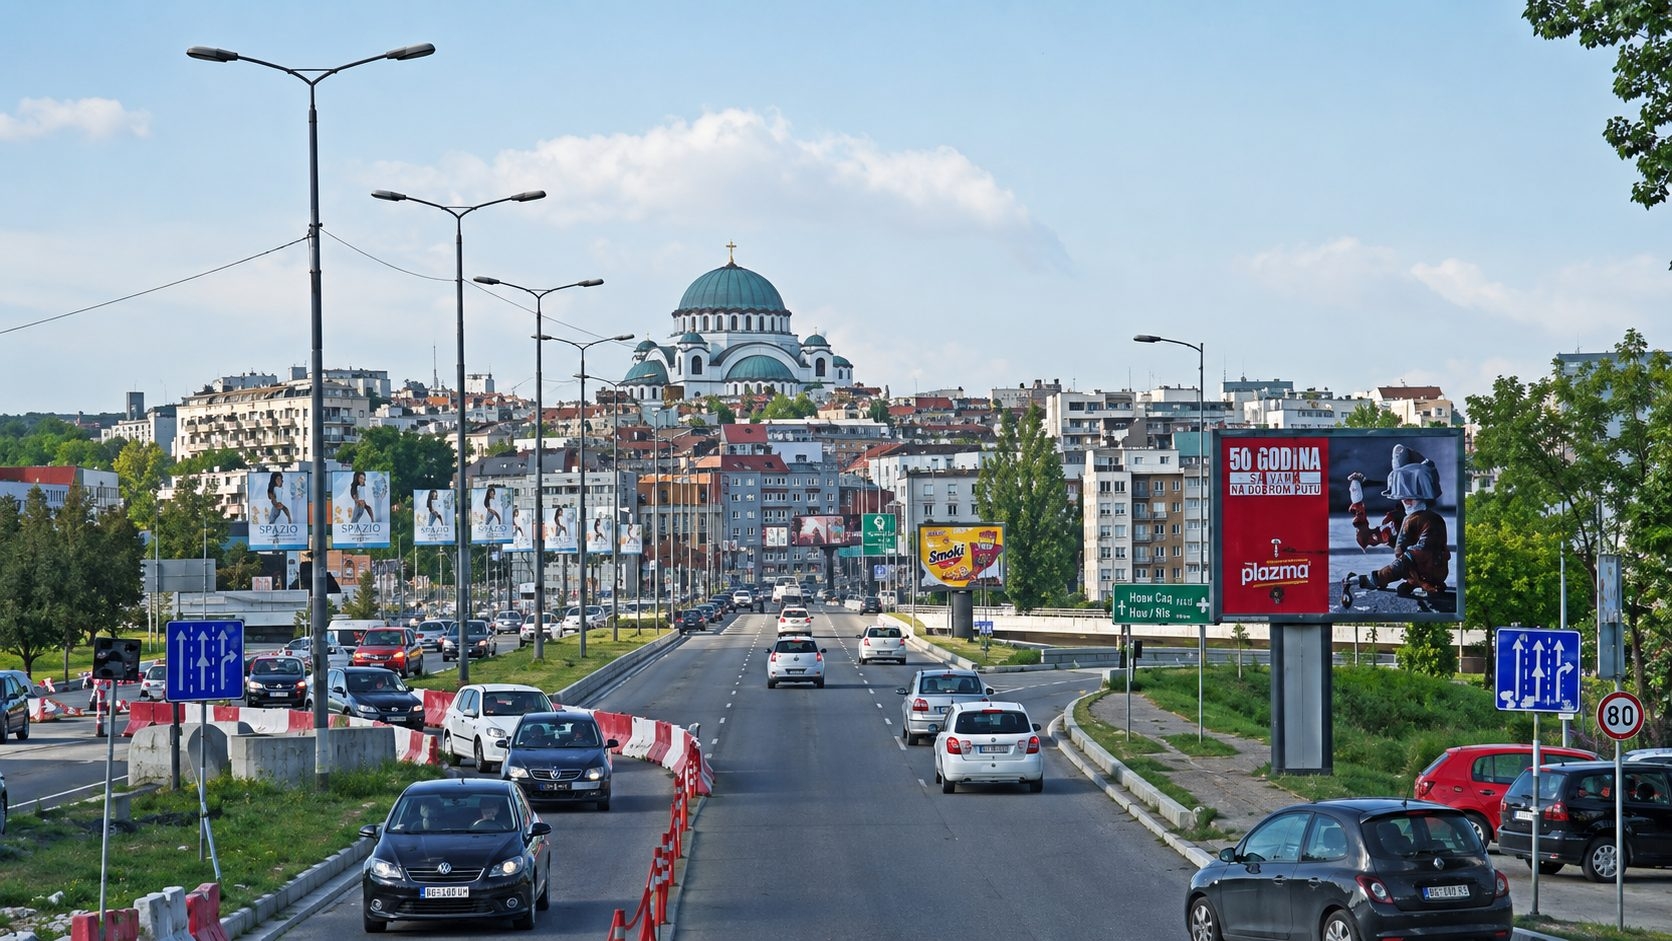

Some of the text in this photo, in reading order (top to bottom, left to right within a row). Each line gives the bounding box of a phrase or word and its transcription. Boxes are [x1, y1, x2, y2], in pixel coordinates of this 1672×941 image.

[1229, 447, 1321, 471] 50 GODINA
[1231, 485, 1321, 495] NA DOBROM PUTU
[259, 524, 298, 534] SPAZIO
[341, 523, 381, 534] SPAZIO
[928, 543, 965, 565] Smoki
[1241, 562, 1309, 586] plazma
[1607, 705, 1634, 727] 80
